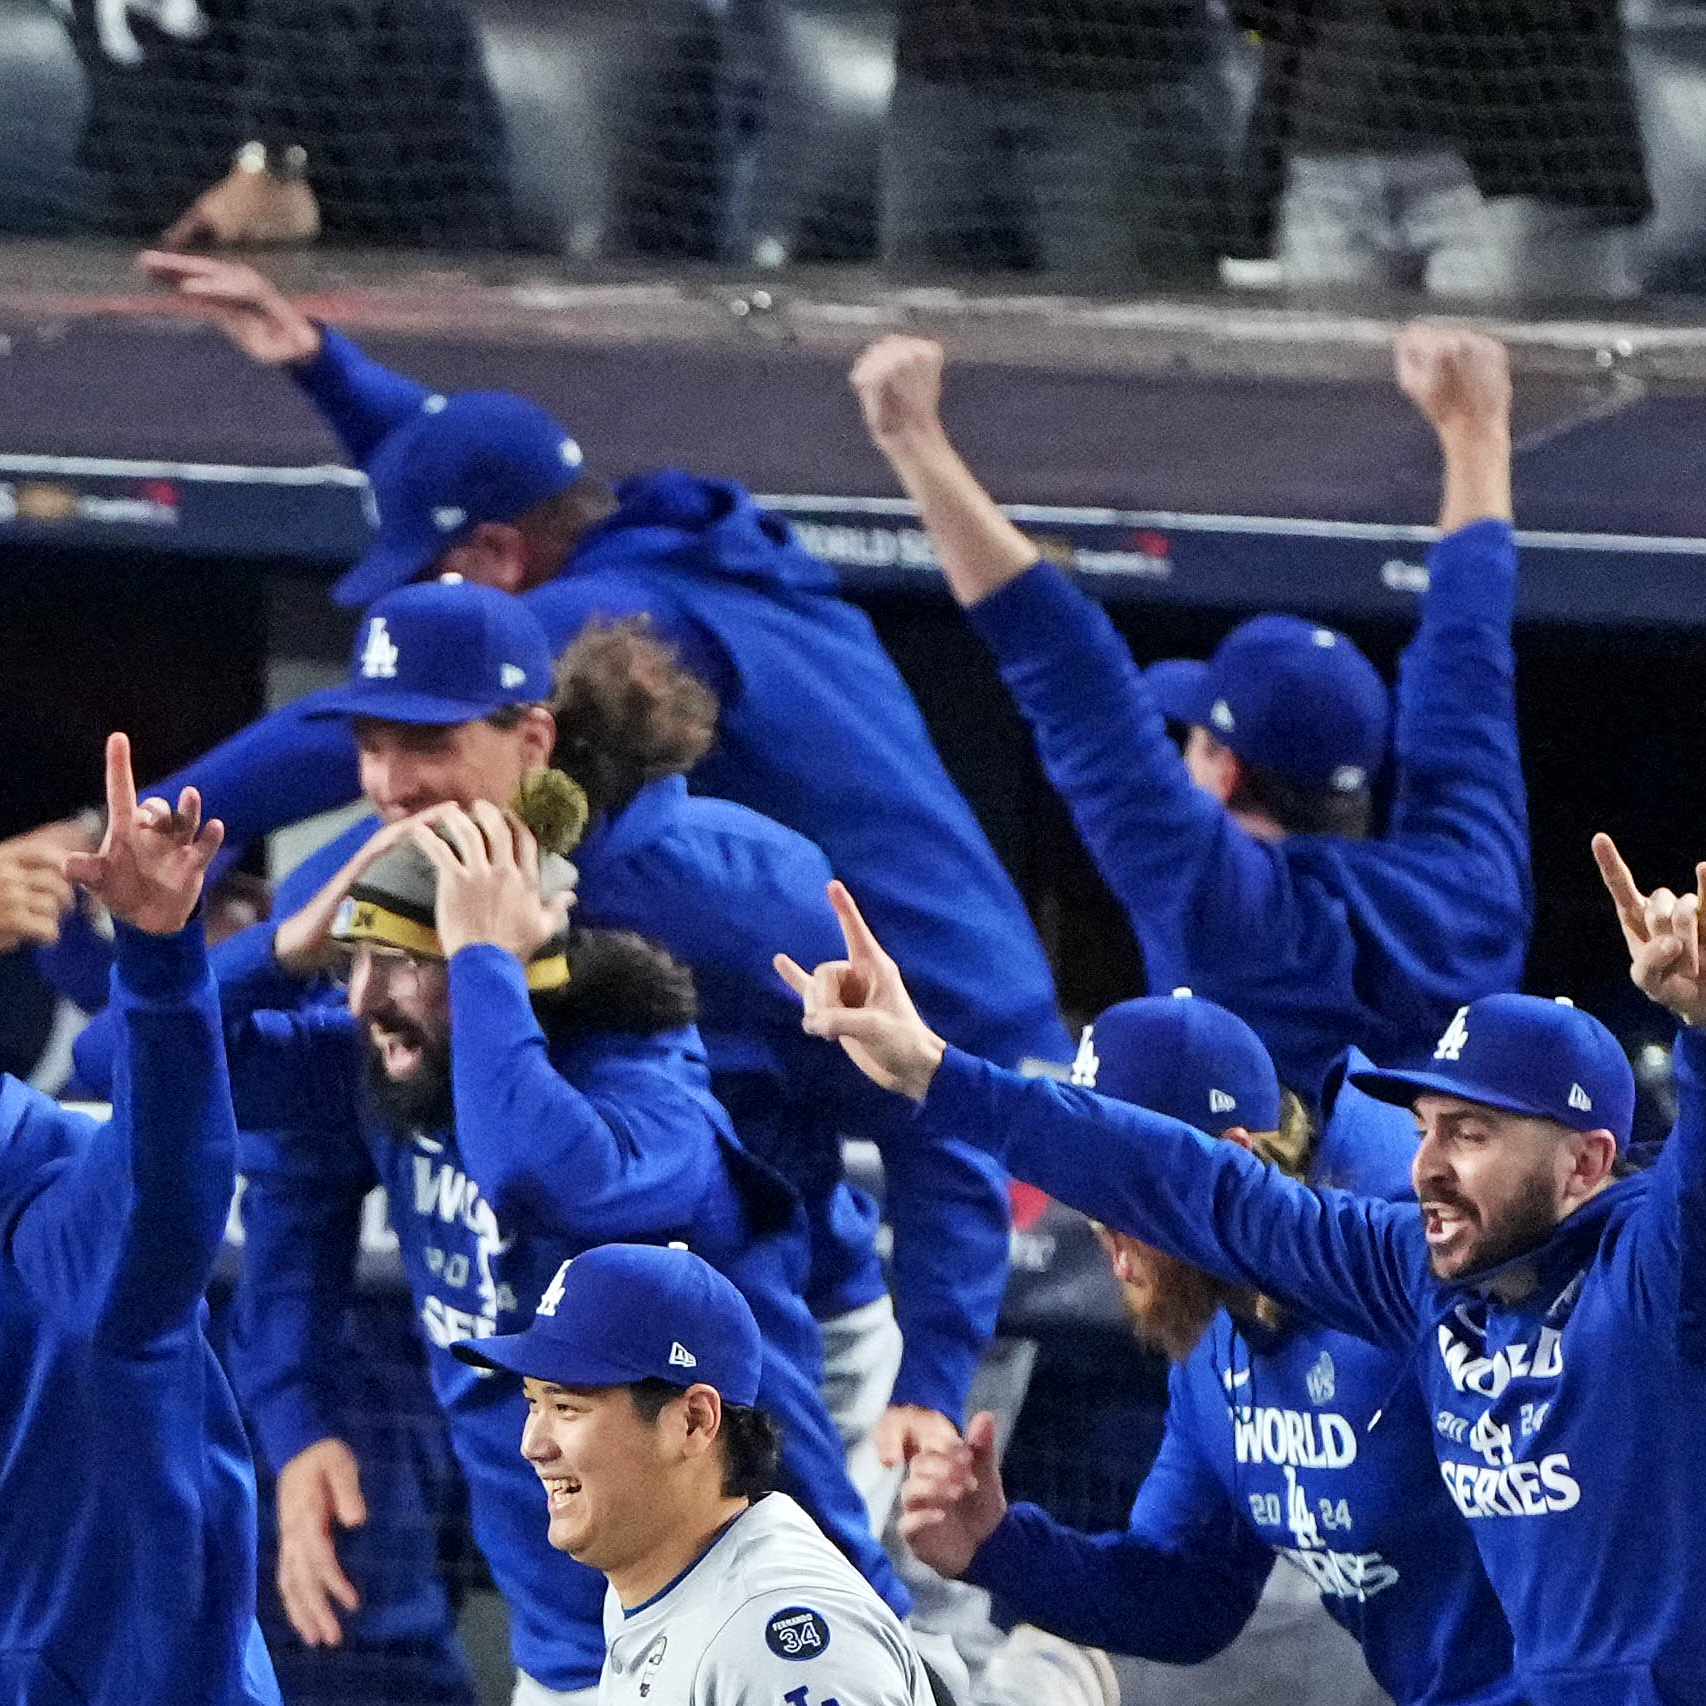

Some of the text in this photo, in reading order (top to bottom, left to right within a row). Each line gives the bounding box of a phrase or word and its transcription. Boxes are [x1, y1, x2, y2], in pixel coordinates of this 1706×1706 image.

[1228, 1406, 1358, 1469] WORLD
[1441, 1453, 1581, 1519] SERIES
[778, 1621, 822, 1654] 34
